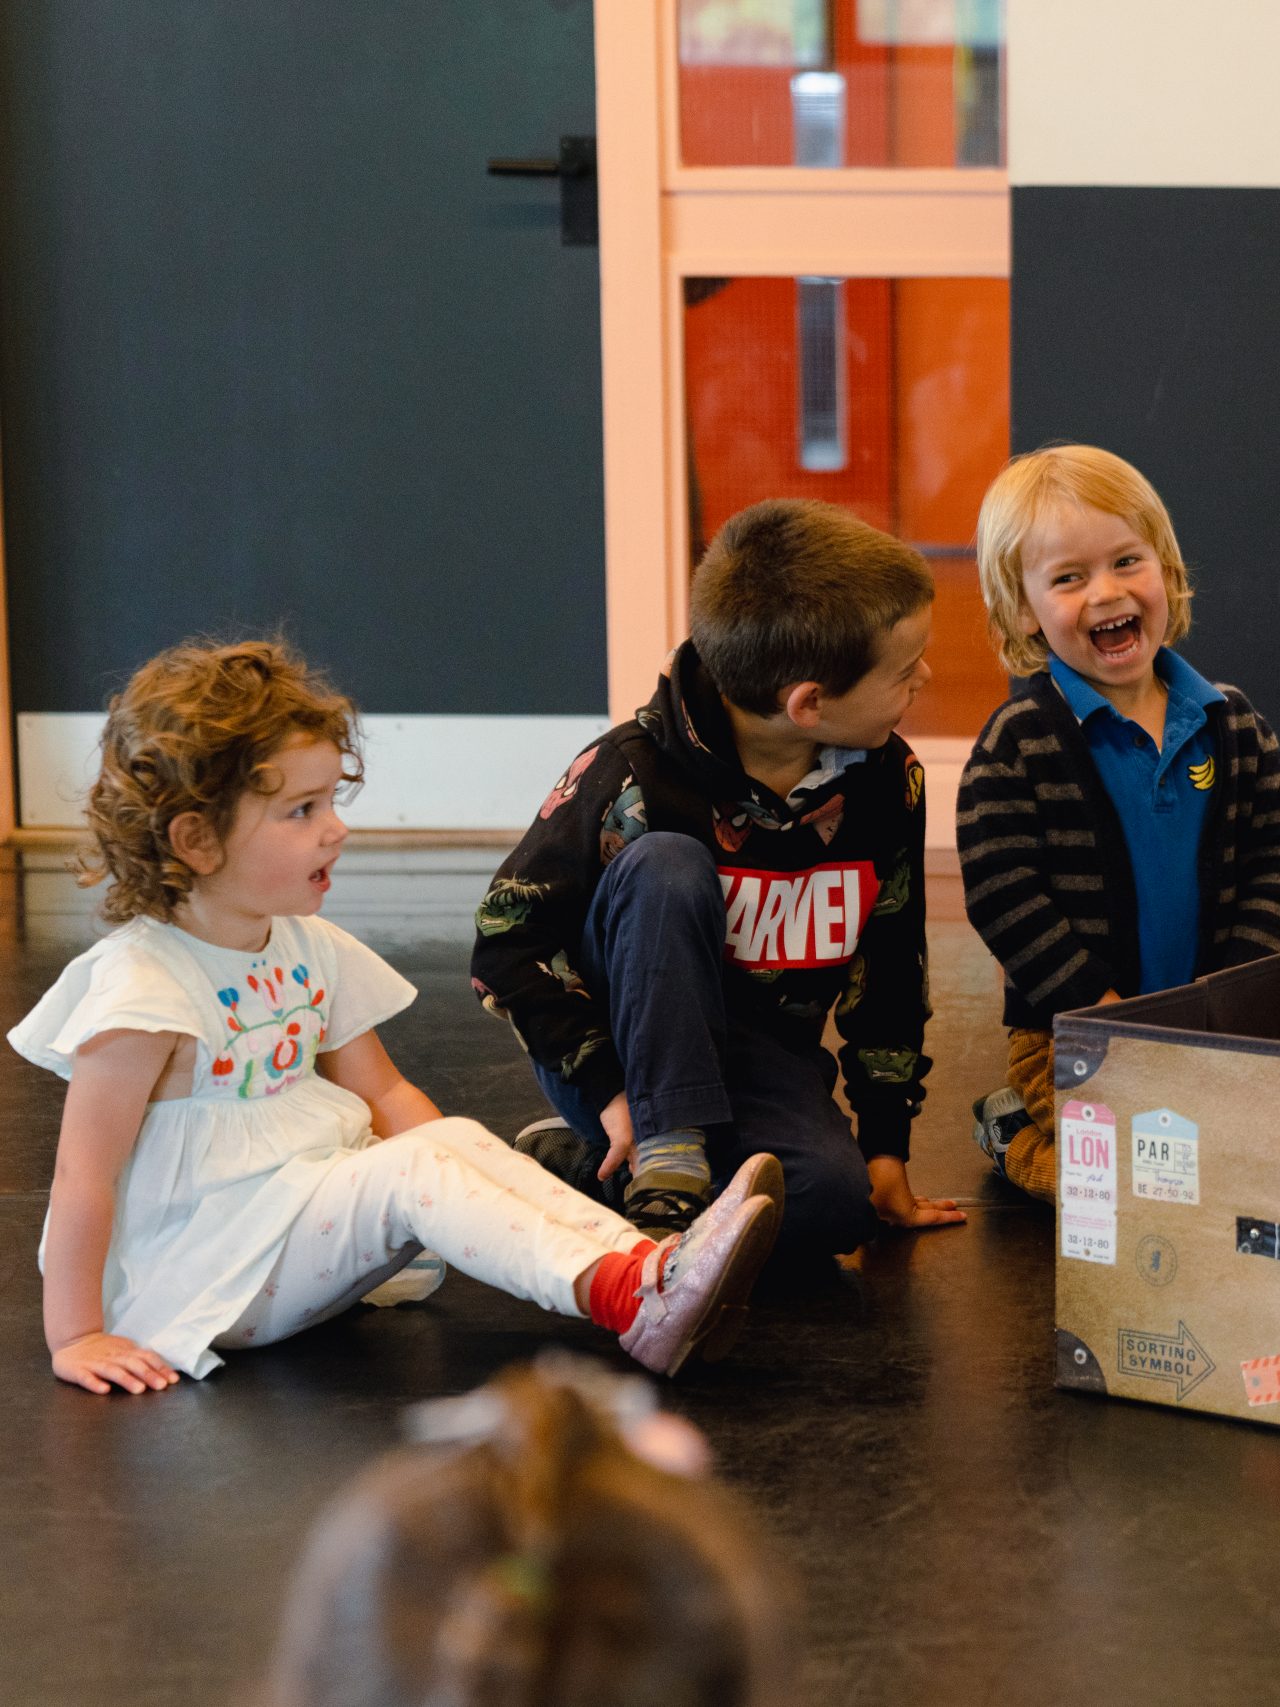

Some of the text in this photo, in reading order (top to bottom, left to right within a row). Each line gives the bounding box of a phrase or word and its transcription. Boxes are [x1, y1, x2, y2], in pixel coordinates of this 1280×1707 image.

[1068, 1134, 1109, 1169] LON
[1137, 1138, 1170, 1161] PAR
[1126, 1338, 1197, 1362] SORTING
[1129, 1353, 1194, 1377] SYMBOL
